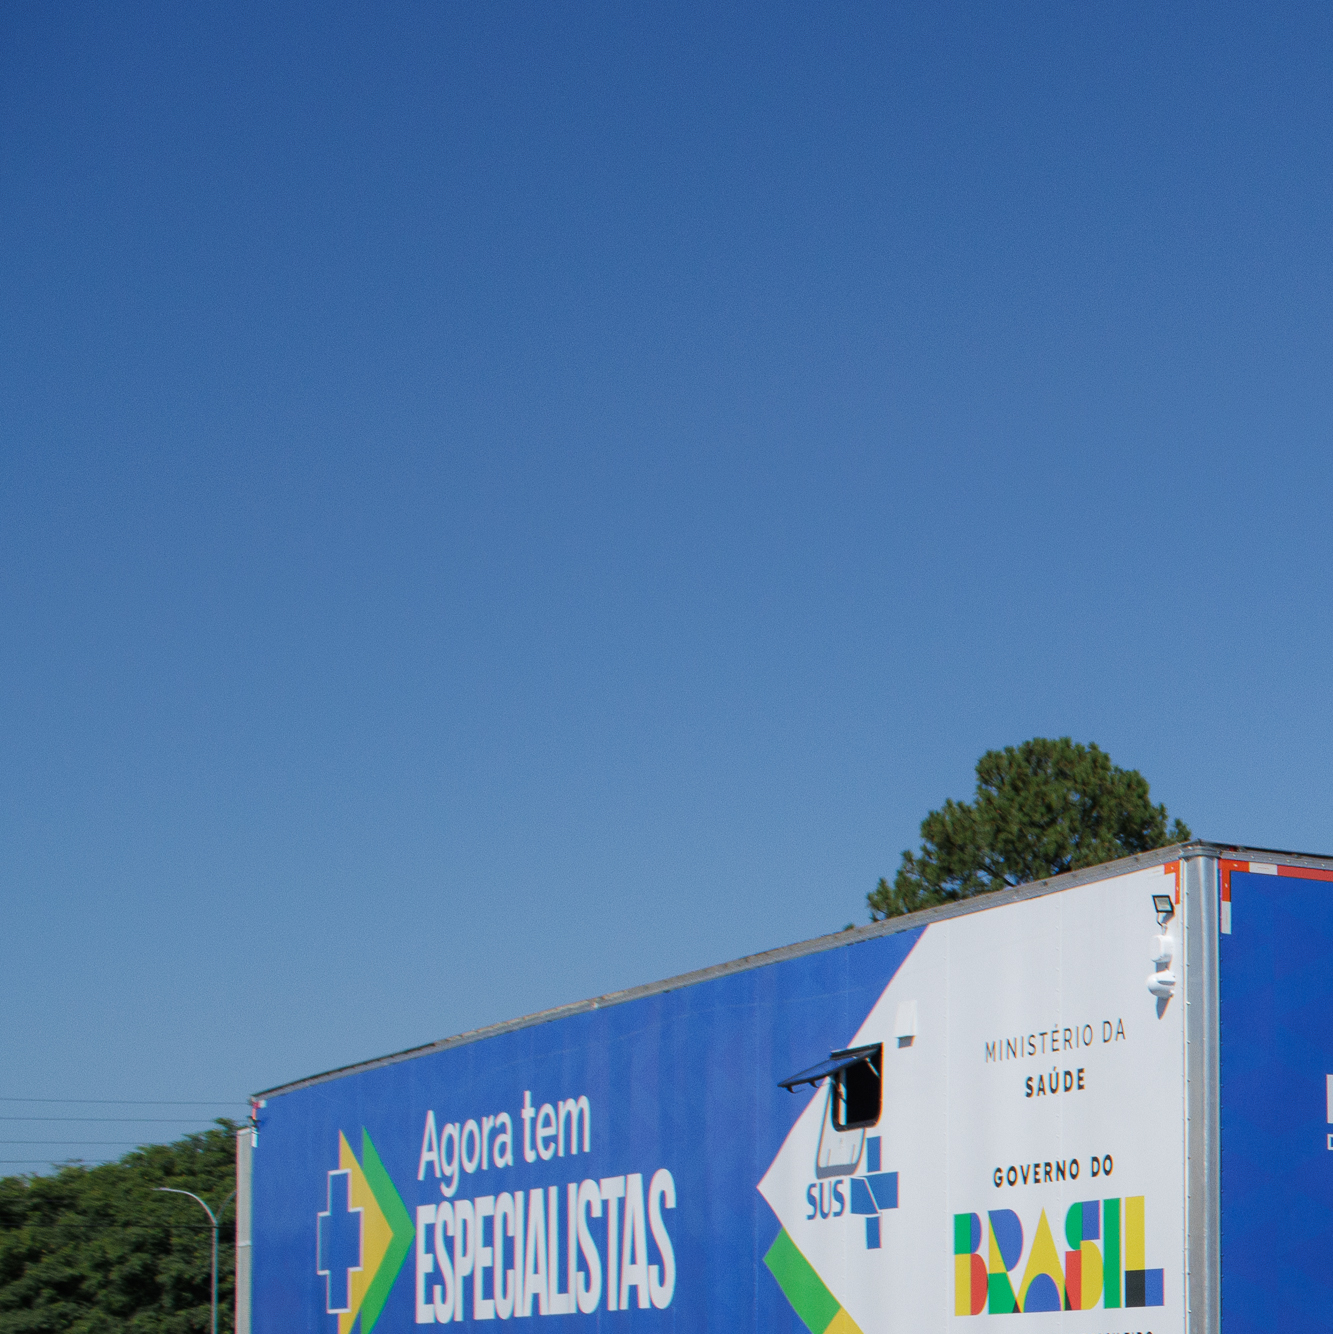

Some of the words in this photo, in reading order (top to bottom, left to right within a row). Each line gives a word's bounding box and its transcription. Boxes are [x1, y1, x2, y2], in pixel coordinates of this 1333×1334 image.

[985, 1024, 1093, 1063] MINISTÉRIO
[1103, 1018, 1126, 1043] DA
[1024, 1066, 1086, 1098] SAÚDE
[417, 1110, 514, 1197] Agora
[522, 1090, 591, 1163] tem
[993, 1158, 1080, 1188] GOVERNO
[1090, 1154, 1113, 1177] DO
[806, 1179, 846, 1220] SUS
[416, 1168, 677, 1324] ESPECIALISTAS
[953, 1195, 1165, 1316] BRASIL
